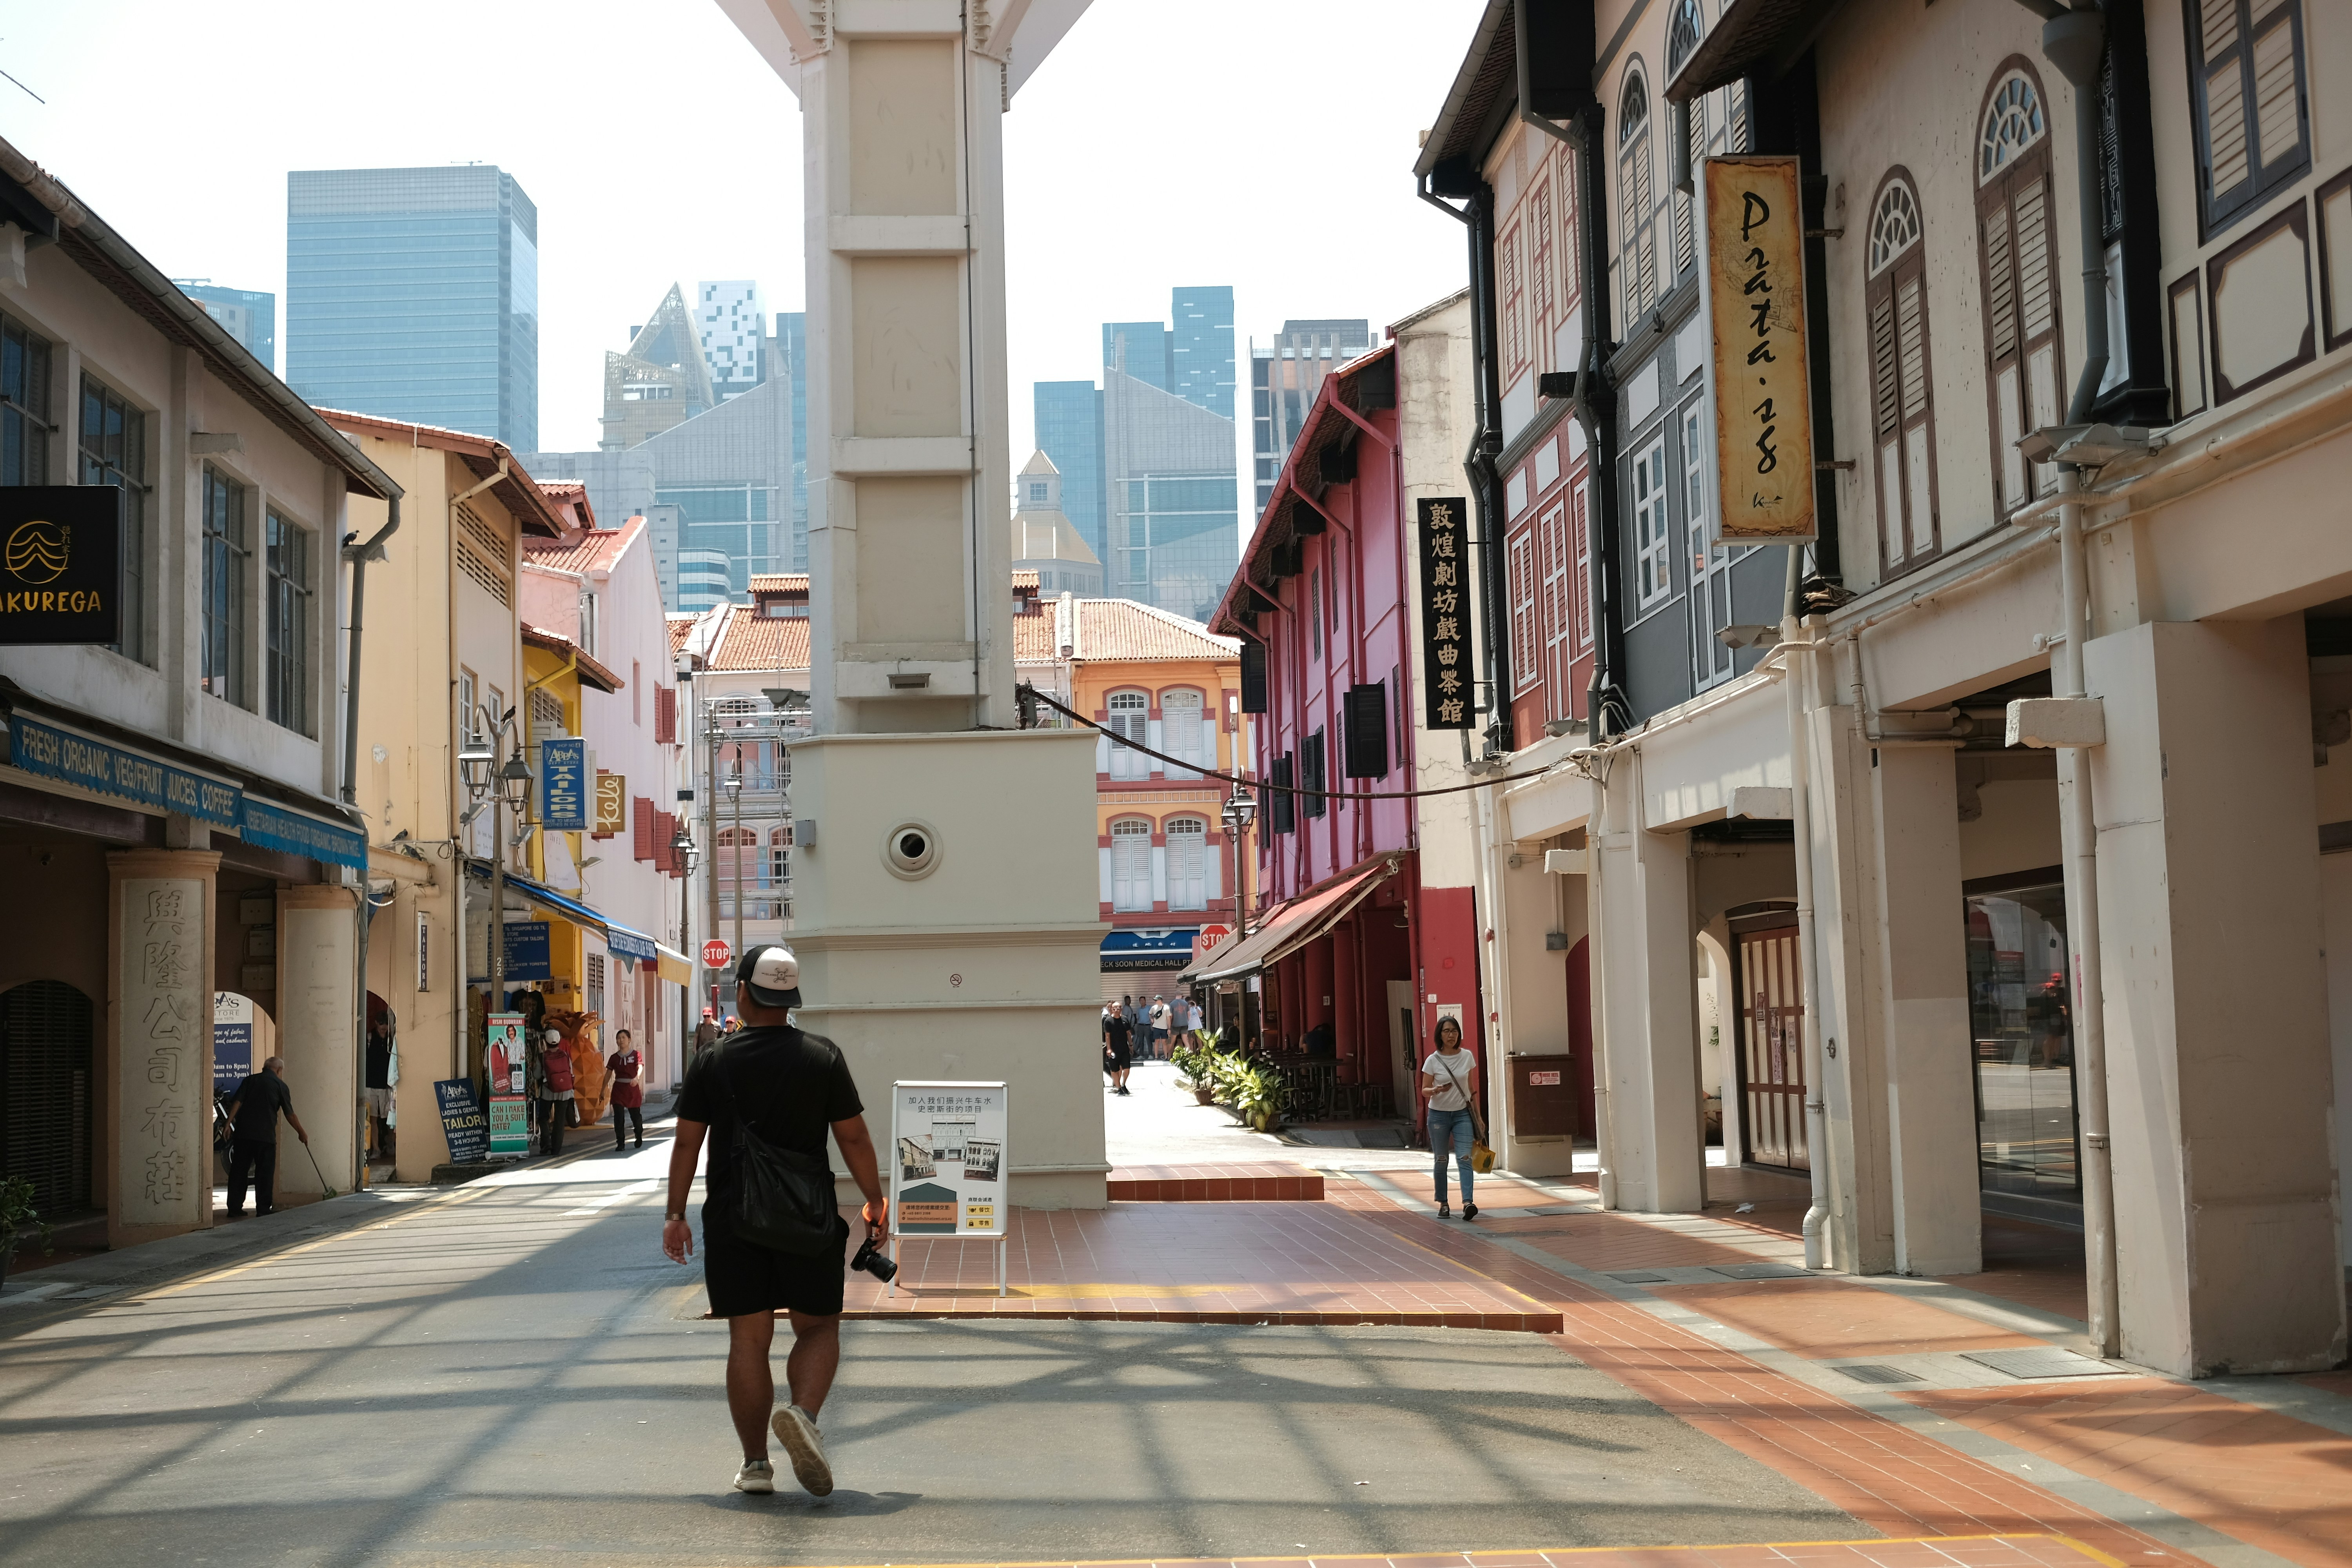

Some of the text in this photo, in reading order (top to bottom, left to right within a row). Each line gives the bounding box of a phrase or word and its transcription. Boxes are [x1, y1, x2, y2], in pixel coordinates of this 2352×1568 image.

[0, 591, 101, 613] KUREGA
[22, 725, 234, 817] FRESH ORGANIC VEG/FRUIT JUICES, COFFEE
[550, 766, 577, 818] TAILORS
[247, 809, 277, 835] VEGETARIAN
[277, 818, 296, 841] HEALTH
[297, 823, 310, 844] FOOD
[311, 828, 331, 851] ORGANIC
[331, 835, 348, 855] BROWN
[1202, 934, 1229, 946] STO
[704, 948, 729, 960] STOP
[224, 1029, 230, 1037] of
[230, 1028, 245, 1037] fabric
[234, 1063, 249, 1071] 8pm)
[446, 1100, 471, 1109] EXCLUSIVE
[505, 1105, 507, 1113] I
[441, 1108, 458, 1116] LADIES
[443, 1114, 482, 1130] TAILOR
